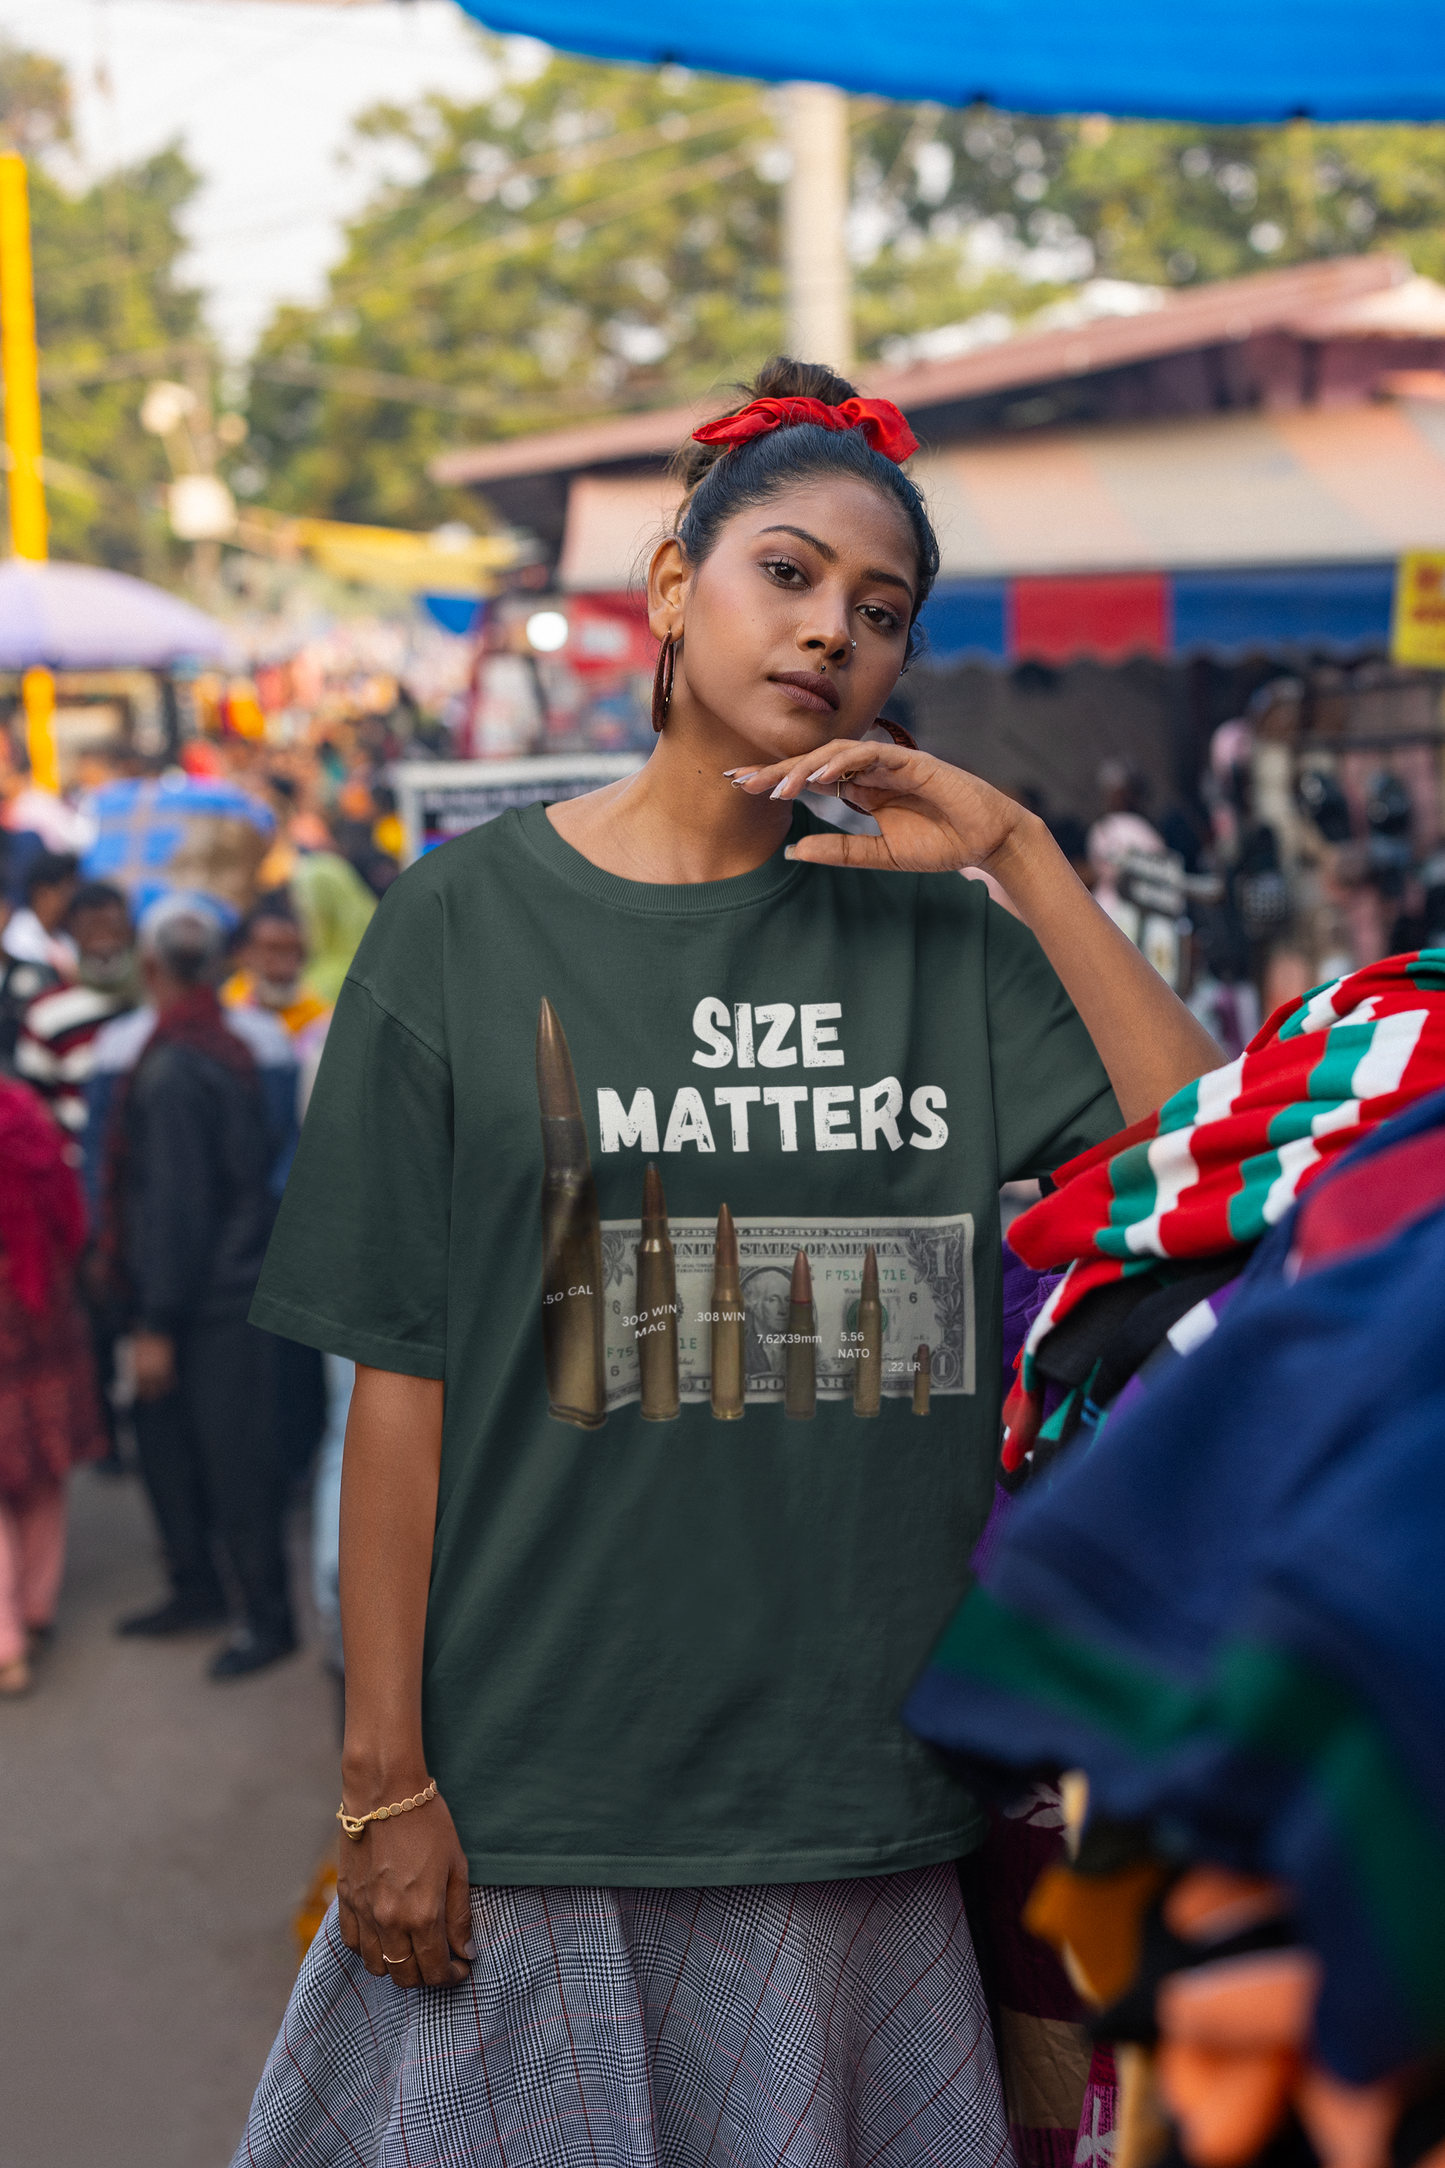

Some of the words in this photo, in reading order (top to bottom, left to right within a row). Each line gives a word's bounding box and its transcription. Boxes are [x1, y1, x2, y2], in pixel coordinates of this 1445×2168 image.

[692, 996, 845, 1068] SIZE
[597, 1076, 949, 1152] MATTERS
[828, 1227, 869, 1236] NOTE
[739, 1243, 800, 1255] STATES
[543, 1291, 564, 1305] .50
[567, 1285, 594, 1297] CAL
[909, 1291, 918, 1305] 6
[621, 1311, 649, 1328] 300
[651, 1304, 677, 1318] WIN
[694, 1311, 720, 1322] .308
[721, 1311, 746, 1322] WIN
[634, 1321, 667, 1339] MAG
[756, 1333, 823, 1344] 7.62X39mm
[840, 1331, 865, 1342] 5.56
[838, 1348, 871, 1359] NATO
[610, 1365, 620, 1377] 6
[887, 1362, 905, 1372] .22
[906, 1362, 922, 1372] LR
